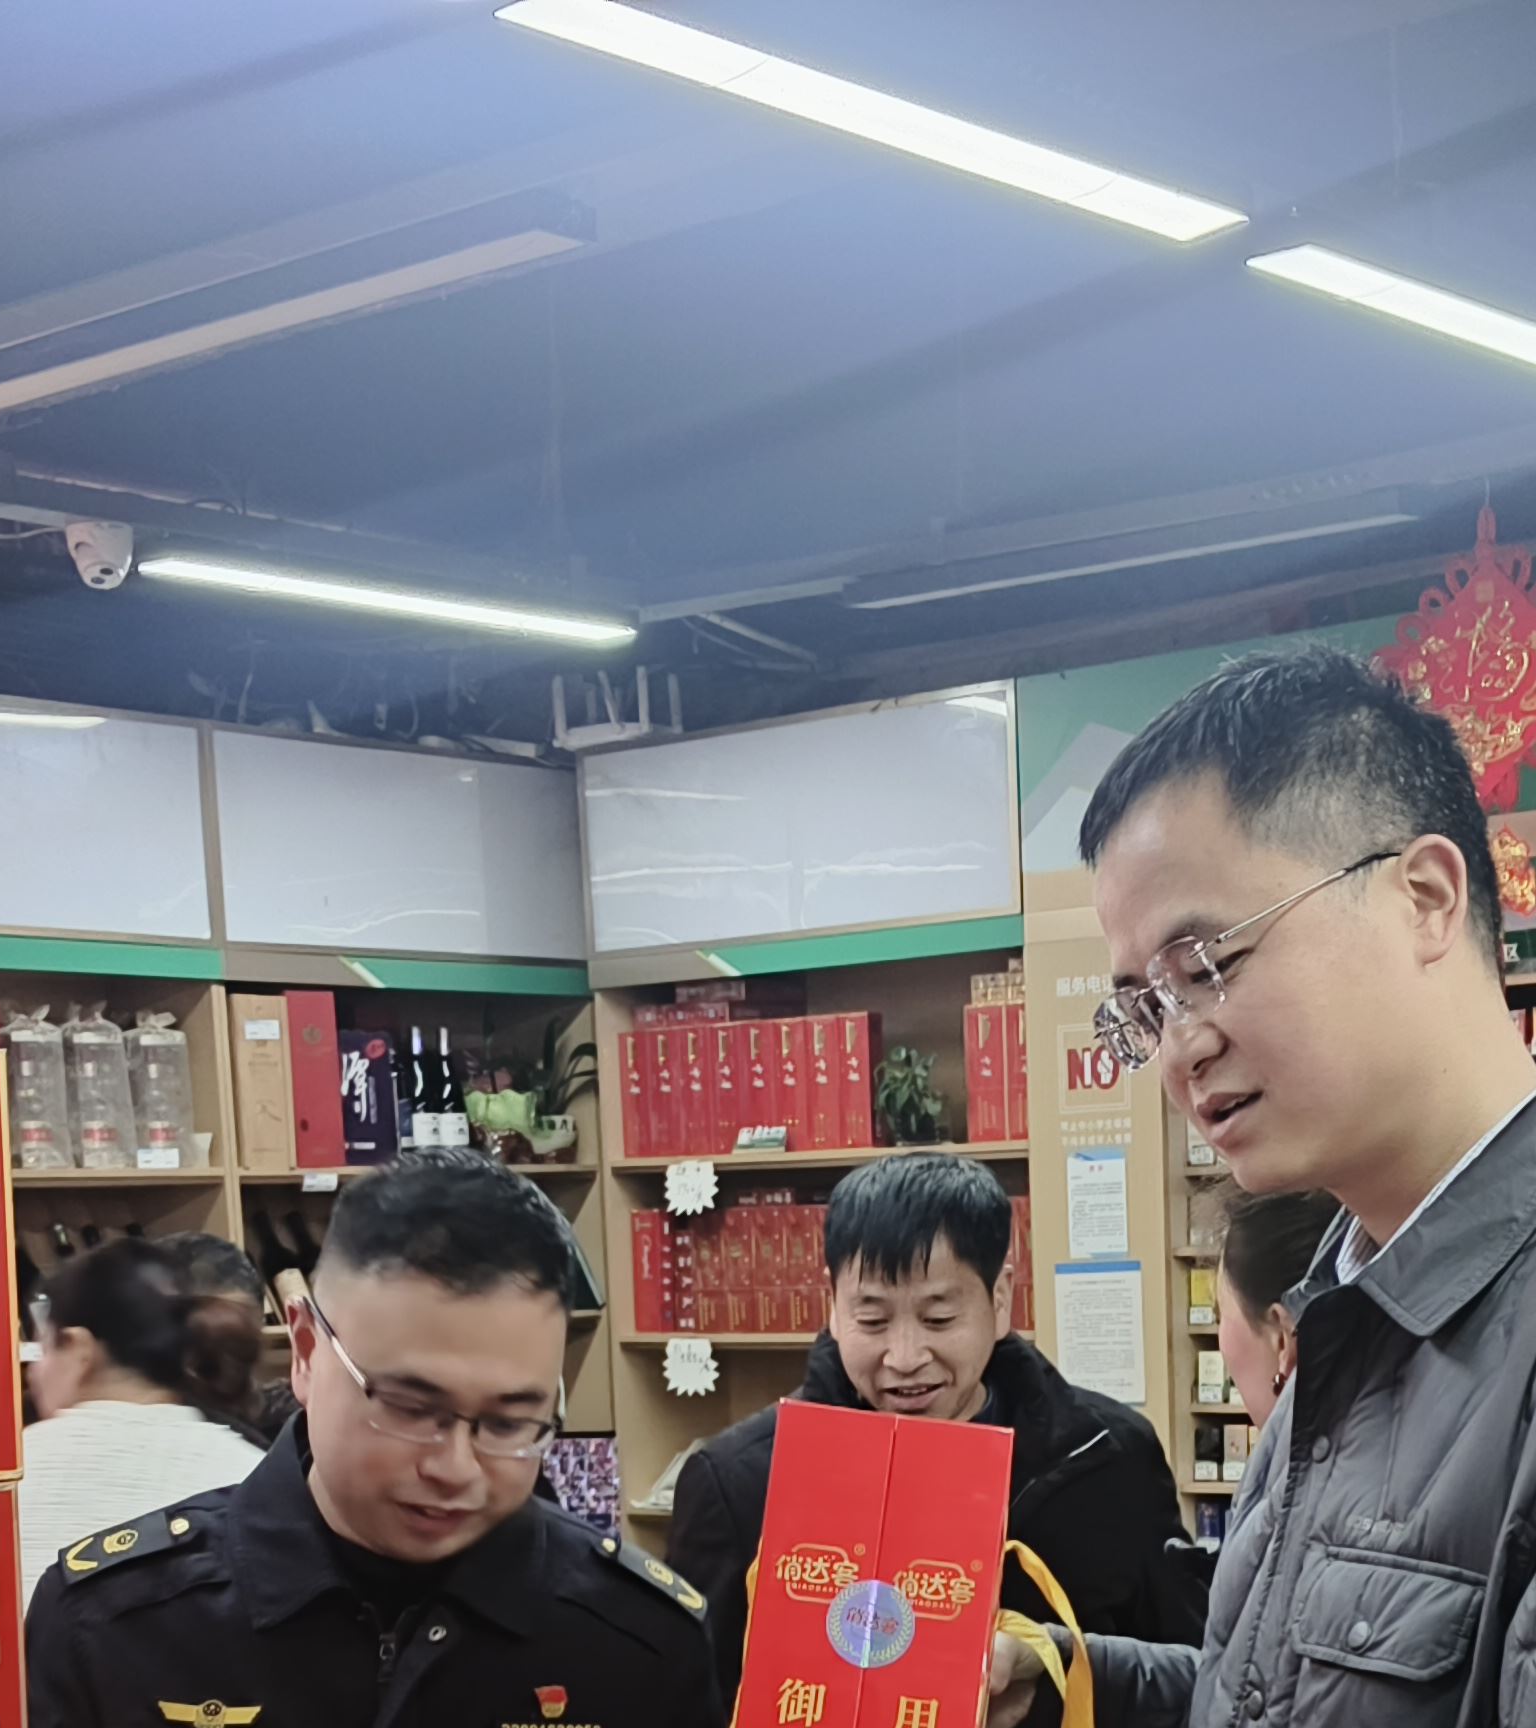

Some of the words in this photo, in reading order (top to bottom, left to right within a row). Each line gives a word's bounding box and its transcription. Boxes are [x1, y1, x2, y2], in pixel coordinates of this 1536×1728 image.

[1067, 1045, 1121, 1090] NO
[776, 1554, 859, 1587] 俏达客
[893, 1570, 976, 1605] 俏达客
